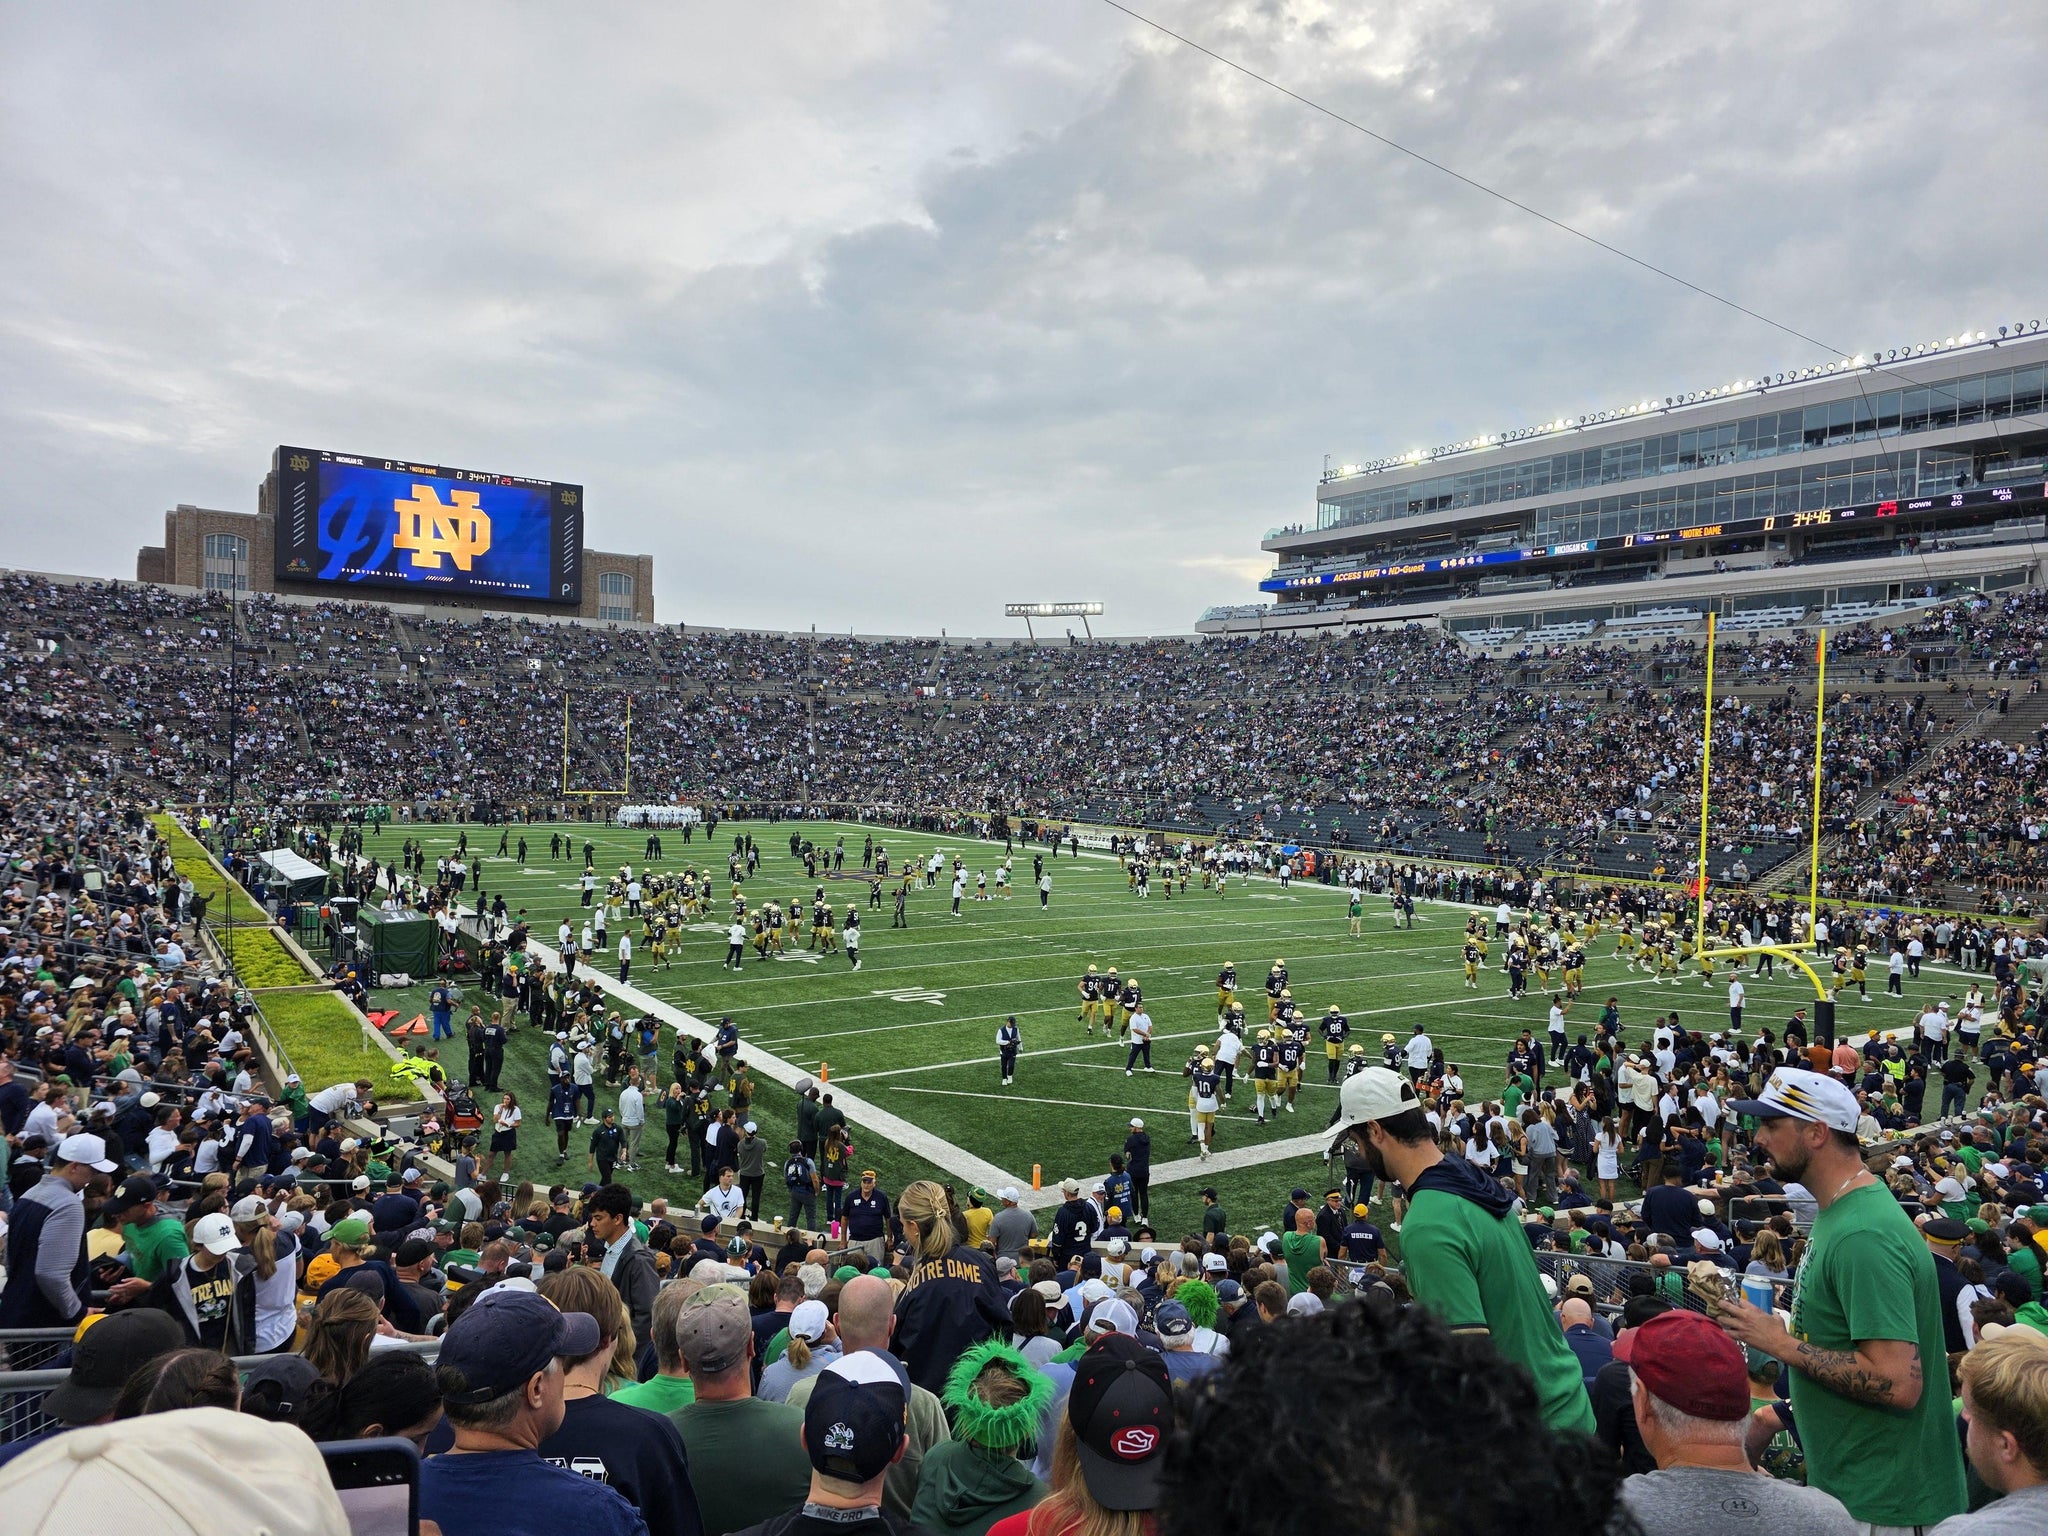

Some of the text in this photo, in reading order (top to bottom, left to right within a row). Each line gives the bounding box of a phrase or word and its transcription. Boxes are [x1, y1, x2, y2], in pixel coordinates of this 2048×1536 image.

[384, 462, 392, 470] 0
[456, 472, 462, 480] 0
[468, 472, 490, 482] 34:47
[501, 478, 512, 486] 25
[1992, 488, 2012, 496] BALL
[1876, 501, 1898, 518] 25
[1908, 500, 1932, 509] DOWN
[1764, 517, 1774, 530] 0
[1792, 510, 1855, 527] 34:46 QTR
[1682, 528, 1703, 539] NOTRE
[1704, 526, 1722, 536] DAME
[1624, 536, 1633, 548] 0
[1554, 544, 1581, 554] MICHIGAN
[1333, 563, 1425, 582] ACCESS WIFI ND-Guest
[1088, 982, 1098, 991] 94
[1108, 984, 1114, 992] 11
[1282, 1008, 1292, 1018] 40
[1330, 1022, 1342, 1034] 88
[1293, 1030, 1304, 1040] 42
[1260, 1049, 1266, 1060] 0
[1284, 1049, 1296, 1061] 60
[1198, 1080, 1210, 1092] 10
[1074, 1221, 1087, 1242] 3
[946, 1258, 982, 1284] DAME
[191, 1283, 212, 1304] TRE
[816, 1508, 864, 1521] NIKE PRO
